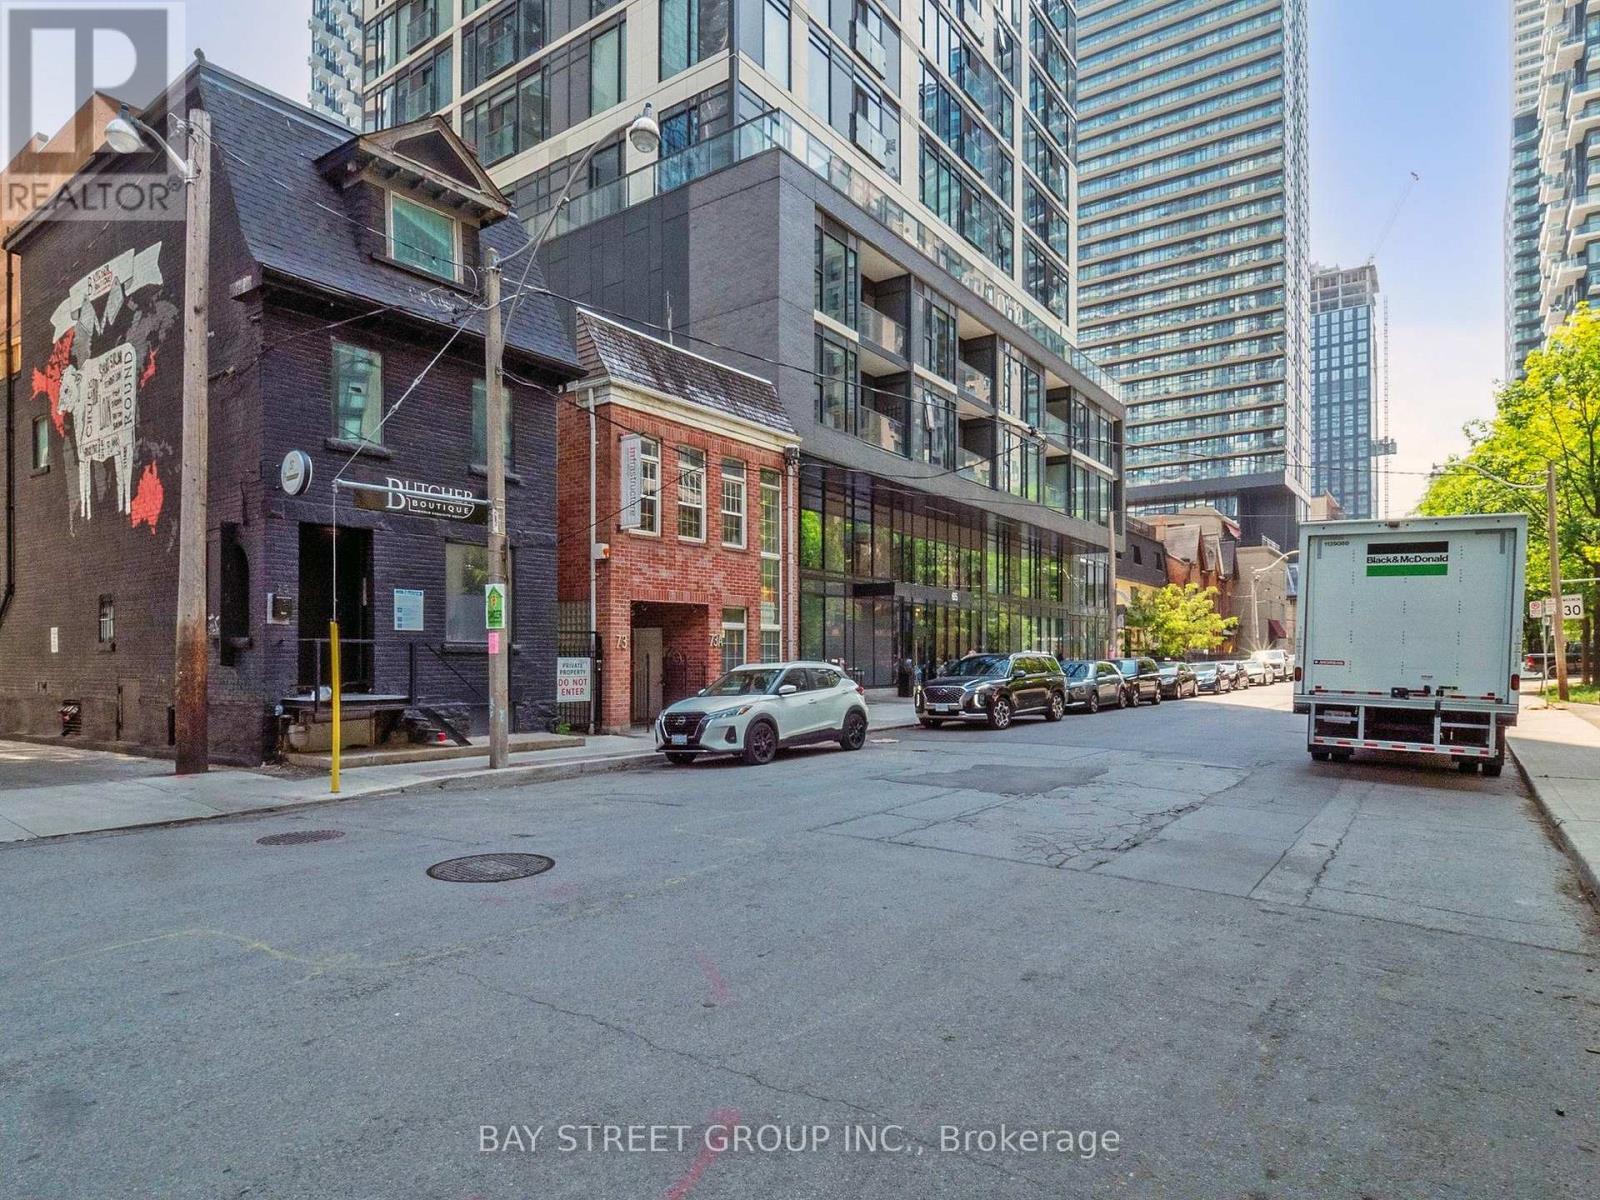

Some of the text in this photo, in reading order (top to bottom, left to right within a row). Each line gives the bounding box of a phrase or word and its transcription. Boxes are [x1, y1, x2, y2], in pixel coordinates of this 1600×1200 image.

[412, 500, 469, 514] BOUTIQUE
[1564, 604, 1581, 616] 30
[616, 634, 628, 649] 73
[558, 678, 588, 687] DO NOT
[561, 687, 585, 696] ENTER
